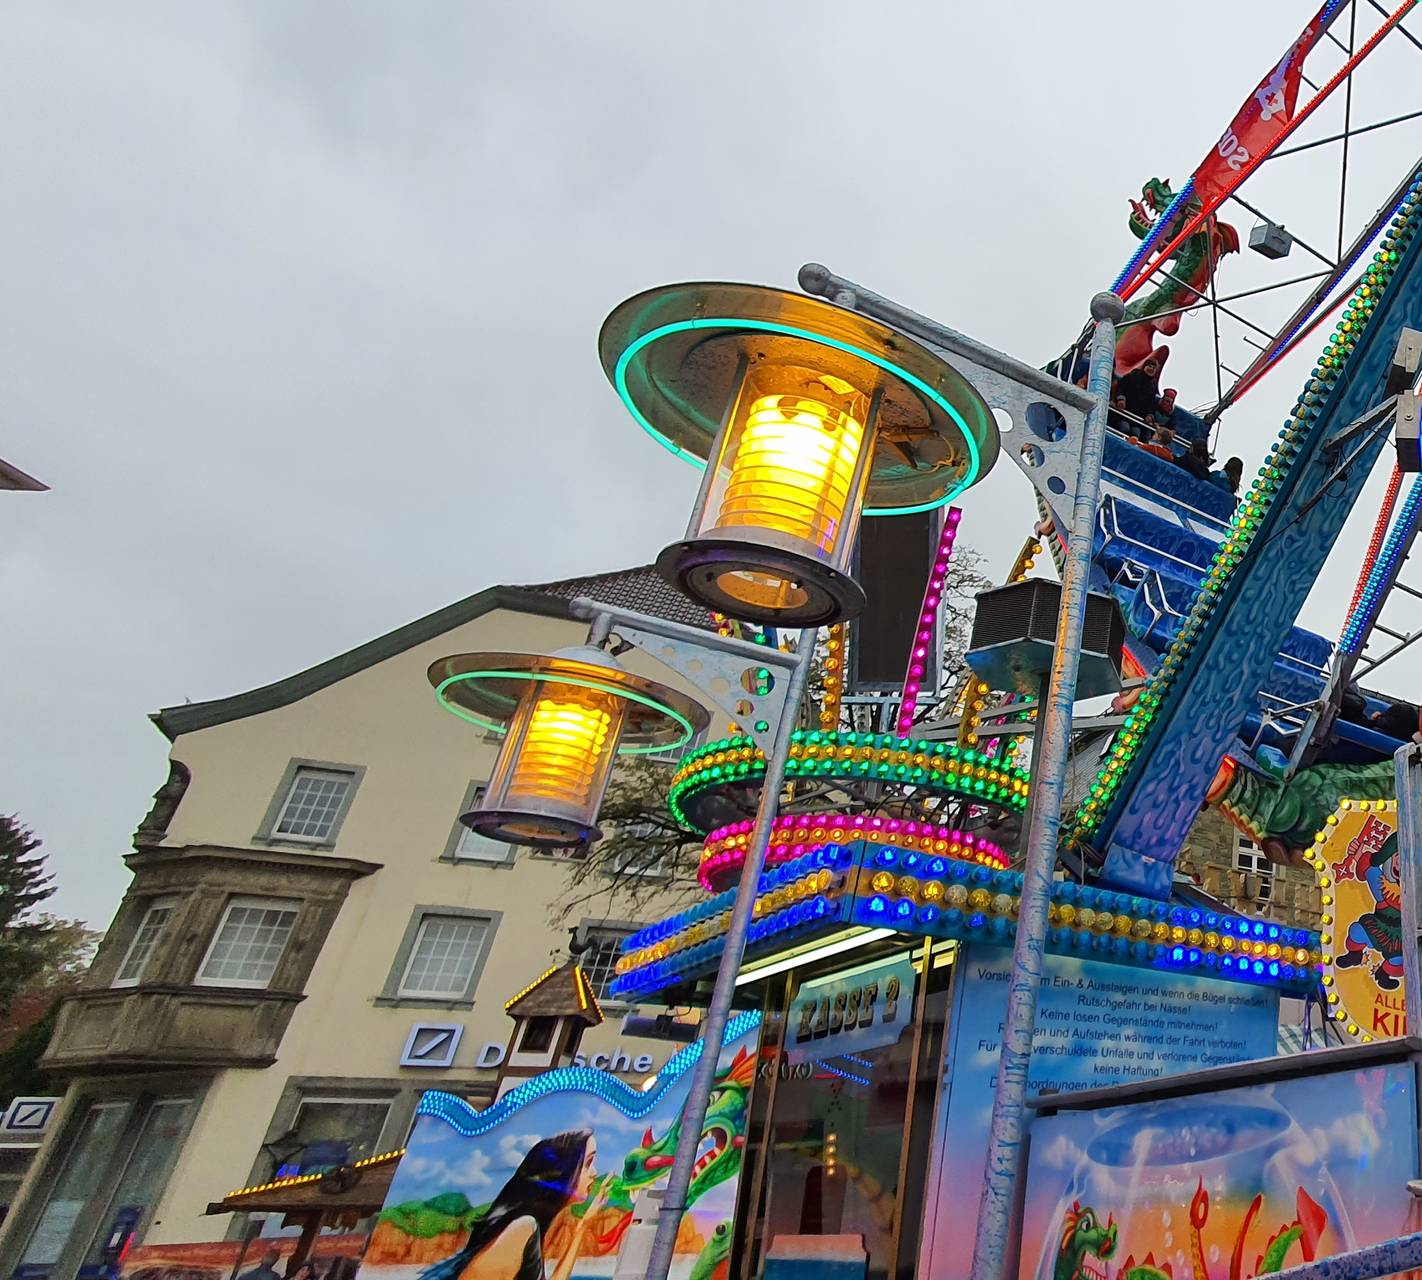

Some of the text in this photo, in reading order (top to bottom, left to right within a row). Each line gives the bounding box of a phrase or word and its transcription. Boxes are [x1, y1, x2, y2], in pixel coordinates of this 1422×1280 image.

[978, 968, 1013, 984] Vorsic
[1053, 976, 1075, 988] Ein-
[1077, 978, 1084, 989] &
[1086, 979, 1139, 996] Aussteigen
[1141, 985, 1159, 996] und
[1161, 989, 1185, 999] wenn
[1187, 991, 1200, 1001] die
[1202, 992, 1226, 1005] Bügel
[796, 983, 878, 1044] KASSE
[1078, 994, 1141, 1012] Rutschgefahr
[1143, 1001, 1158, 1012] bei
[1040, 1008, 1218, 1032] Keine losen Gegenstände mitnehmen!
[1050, 1026, 1069, 1038] und
[1072, 1027, 1121, 1041] Aufstehen
[1124, 1032, 1164, 1045] während
[1166, 1035, 1181, 1046] der
[1183, 1035, 1205, 1047] Fahrt
[1207, 1038, 1247, 1050] verboten!
[474, 1041, 654, 1073] Dsche
[978, 1039, 998, 1052] Für
[1137, 1049, 1155, 1061] und
[1157, 1052, 1198, 1063] verlorene
[1093, 1063, 1163, 1077] keine Haftung!
